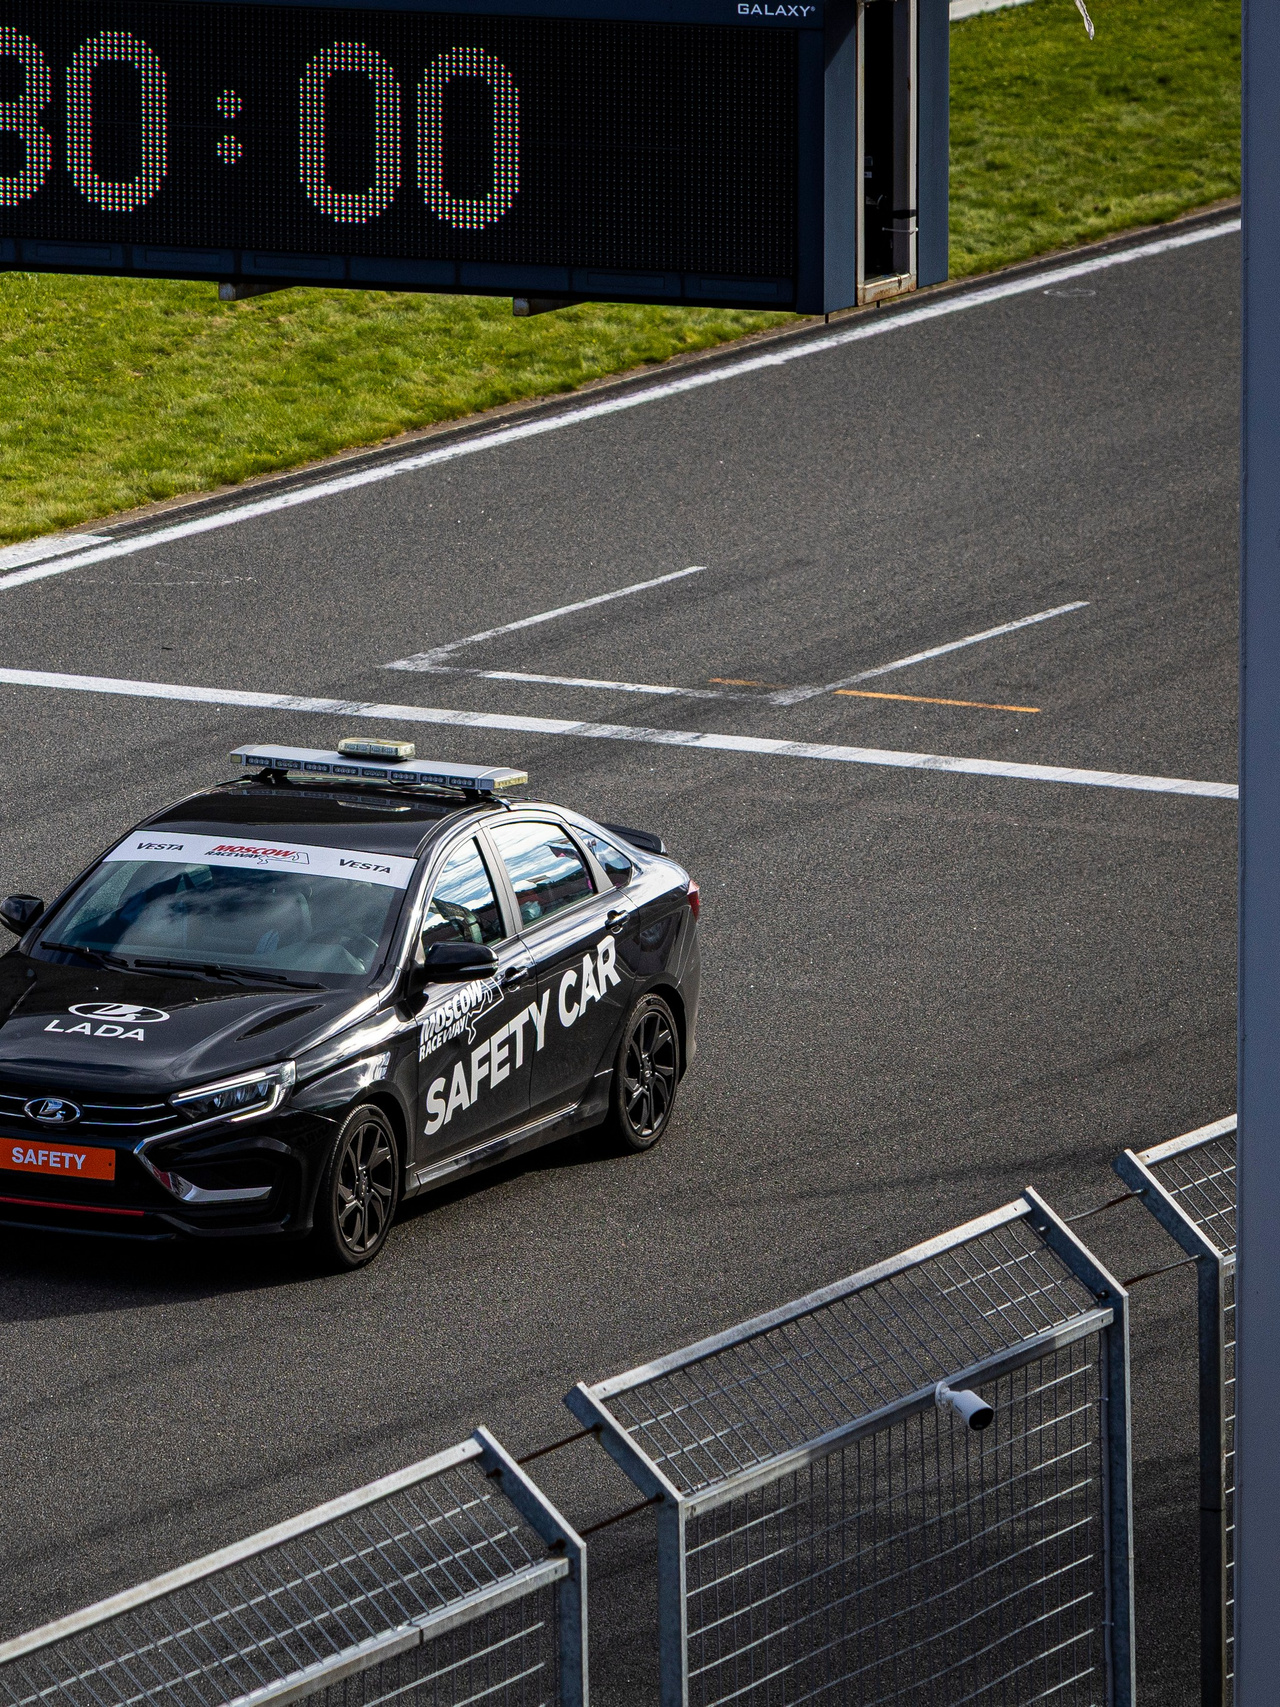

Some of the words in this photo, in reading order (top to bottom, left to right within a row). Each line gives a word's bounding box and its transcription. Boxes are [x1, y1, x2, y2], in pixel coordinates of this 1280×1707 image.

[136, 842, 185, 852] VESTA
[204, 851, 261, 860] RACEWAY
[212, 844, 297, 857] MOSCOW
[338, 858, 392, 874] VESTA
[420, 979, 483, 1046] MOSCOW
[43, 1019, 146, 1042] LADA
[418, 1015, 466, 1062] RACEWAY
[423, 988, 551, 1136] SAFETY
[558, 934, 622, 1028] CAR
[11, 1146, 87, 1170] SAFETY
